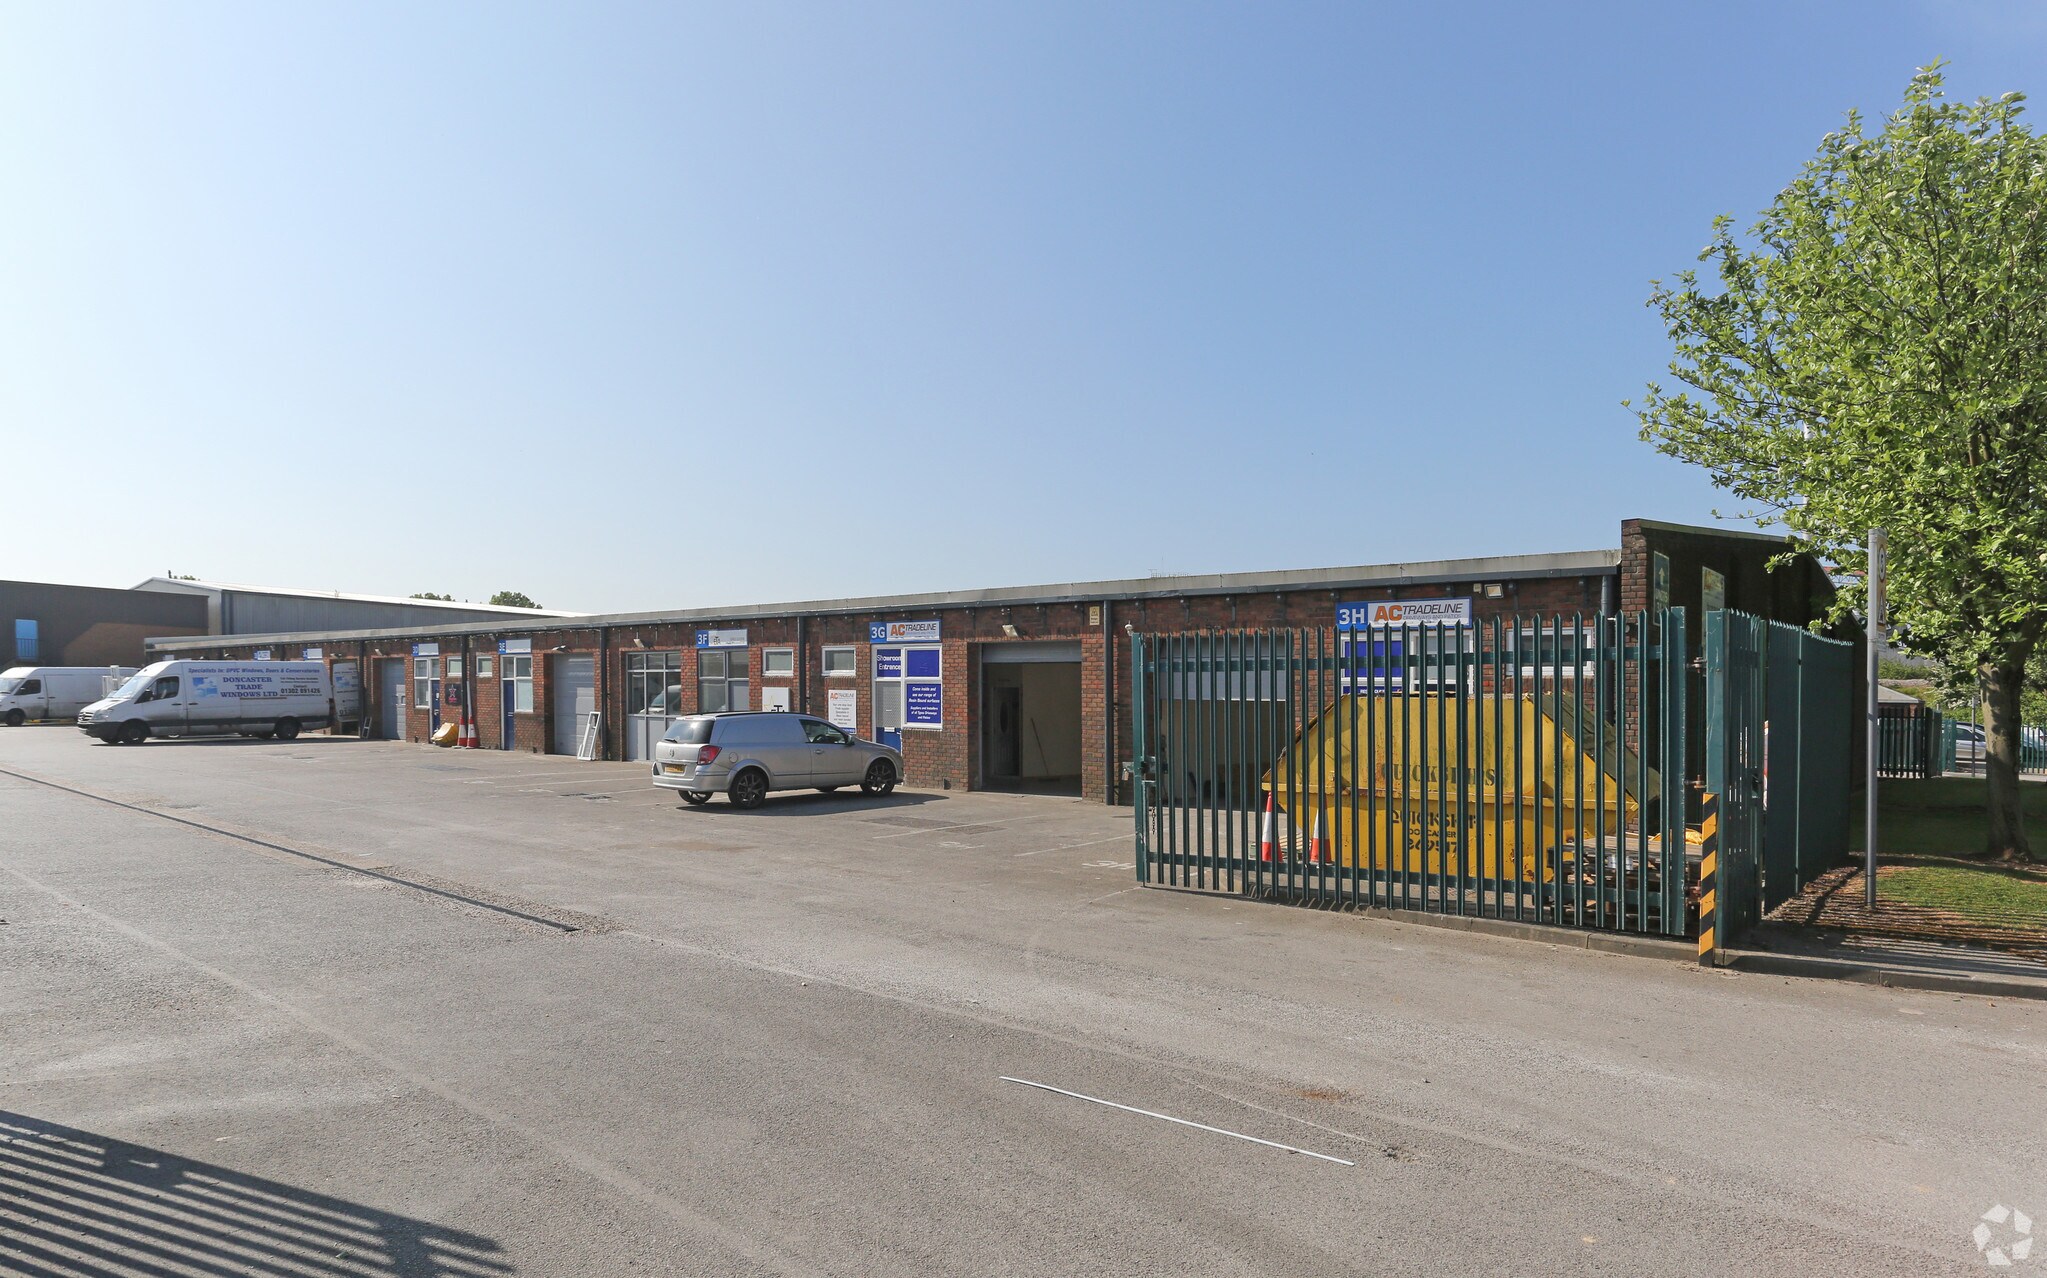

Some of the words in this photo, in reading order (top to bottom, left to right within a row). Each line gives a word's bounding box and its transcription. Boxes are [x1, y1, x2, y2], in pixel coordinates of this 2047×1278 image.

[1339, 608, 1365, 625] 3H
[1374, 605, 1402, 622] AC
[1402, 603, 1463, 615] TRADELINE
[871, 626, 886, 639] 3G
[890, 624, 905, 637] AC
[905, 623, 937, 632] TRADELINE
[697, 634, 708, 645] 3F
[878, 663, 902, 671] Entrance
[1390, 809, 1477, 830] QICKSP
[1405, 828, 1458, 839] DOCAER
